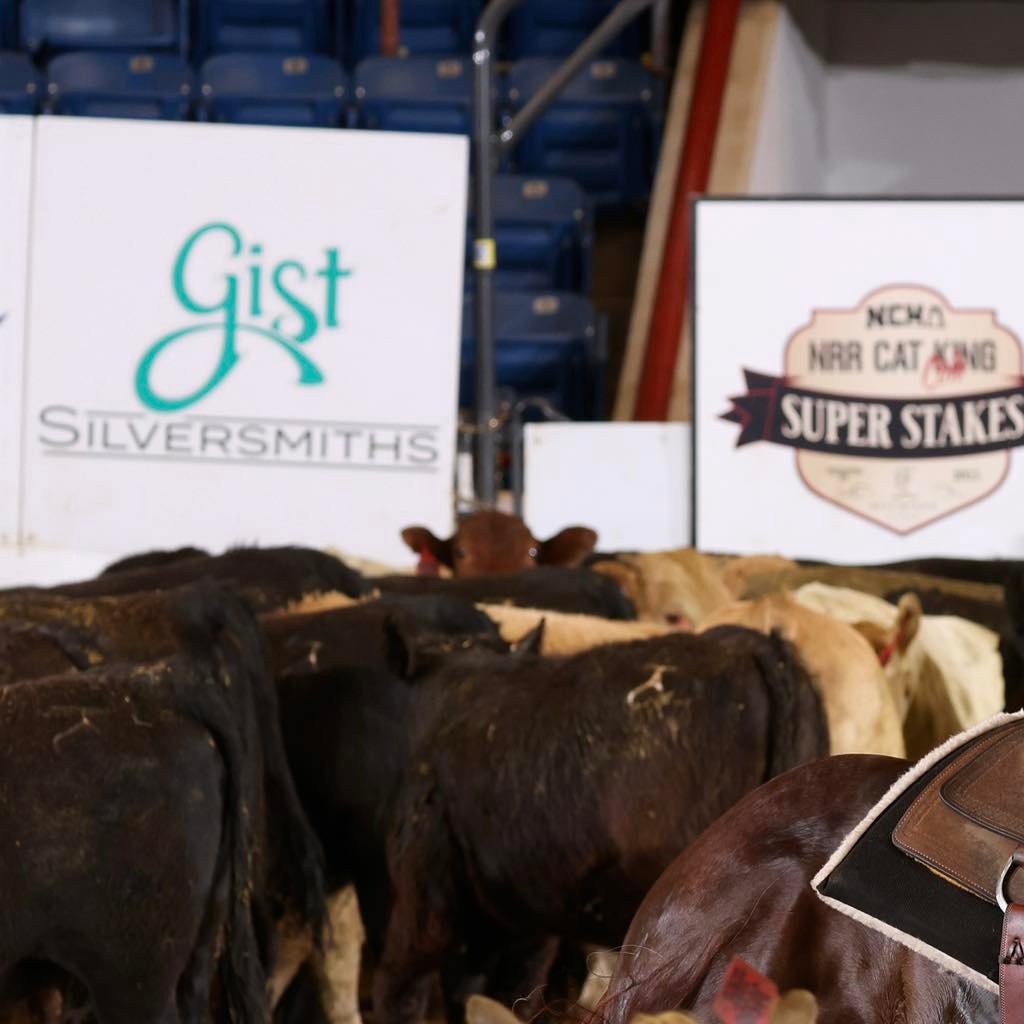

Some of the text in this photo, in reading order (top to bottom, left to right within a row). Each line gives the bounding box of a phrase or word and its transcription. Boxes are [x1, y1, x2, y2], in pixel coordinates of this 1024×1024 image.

[134, 222, 353, 413] Gist
[808, 339, 863, 373] NRR
[872, 339, 921, 373] CAT
[38, 404, 439, 464] SILVERSMITHS
[779, 393, 894, 450] SUPER
